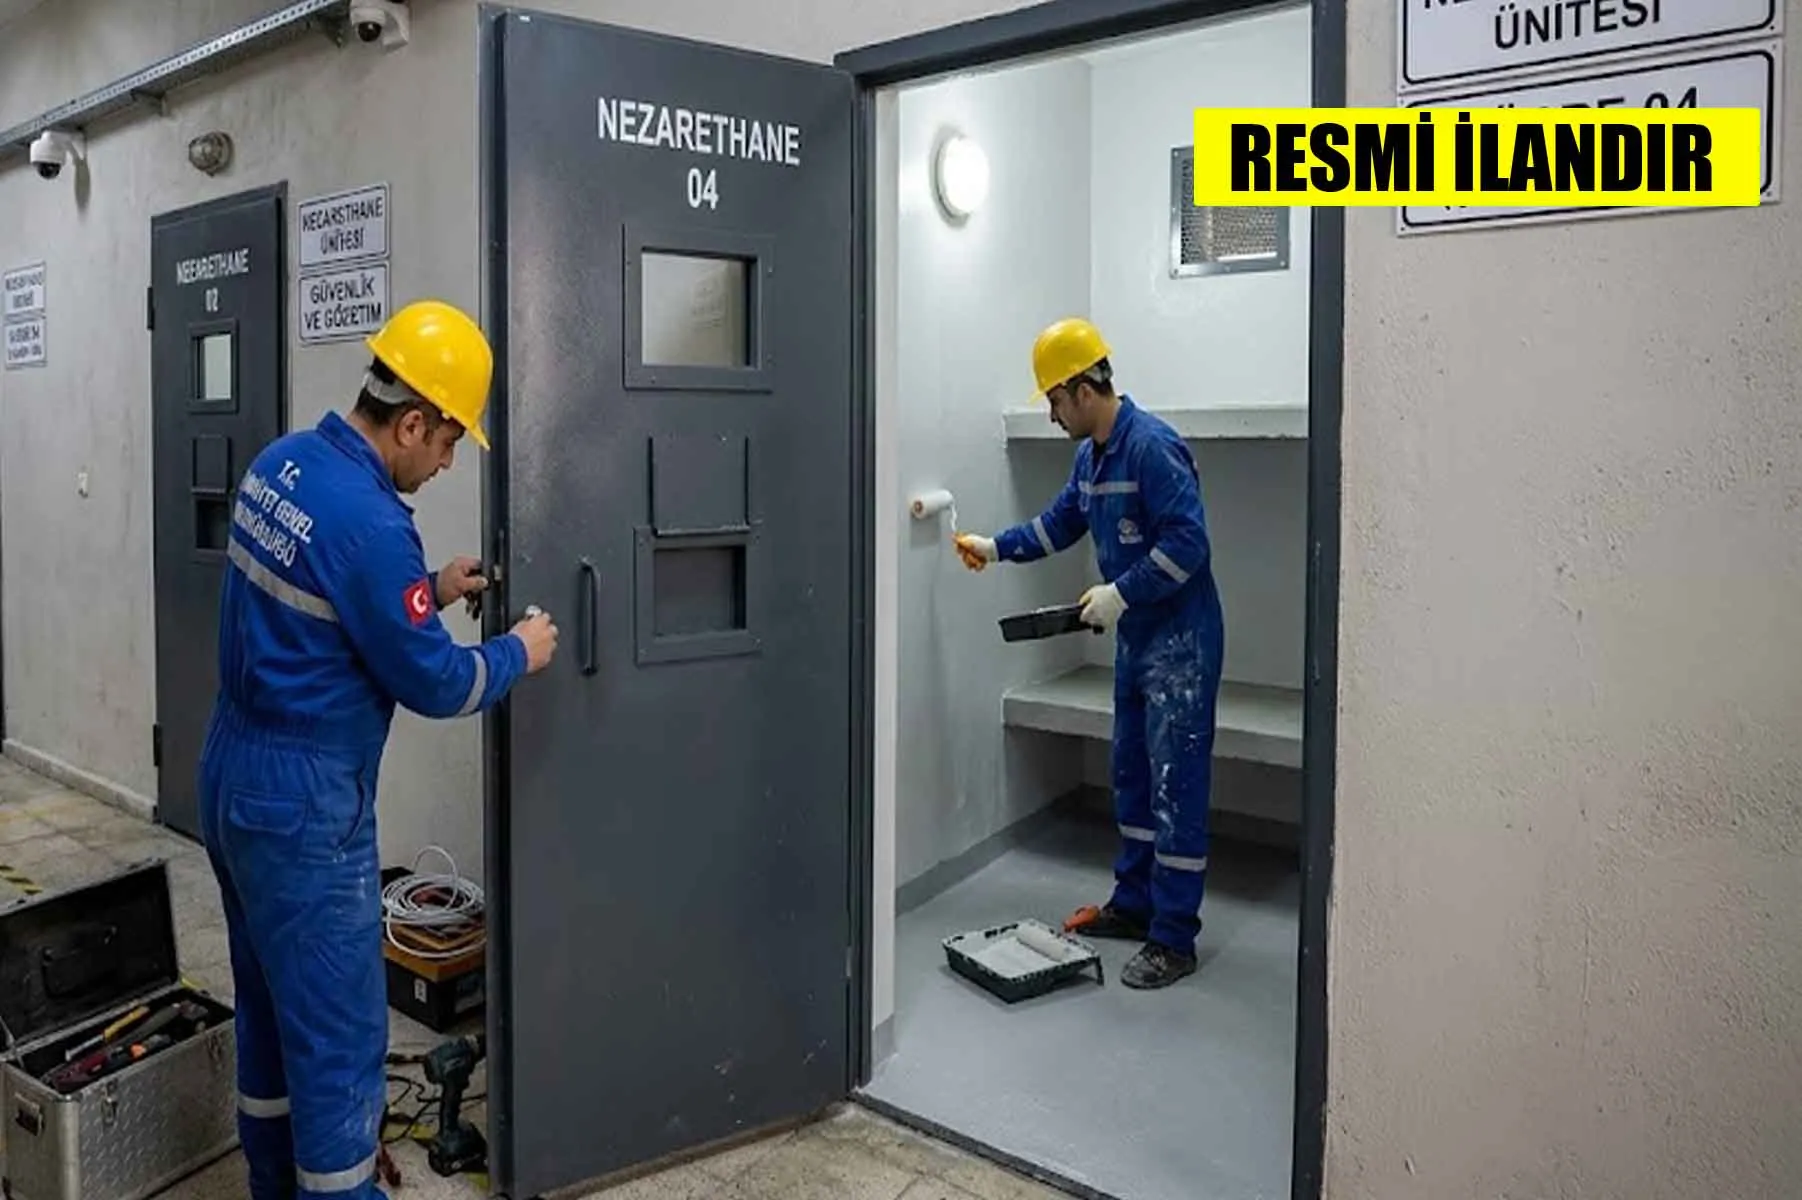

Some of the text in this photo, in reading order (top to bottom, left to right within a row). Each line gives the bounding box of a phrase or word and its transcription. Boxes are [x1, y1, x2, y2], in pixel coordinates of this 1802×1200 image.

[598, 96, 800, 166] NEZARETHANE
[687, 167, 720, 210] 04
[304, 310, 321, 331] VE
